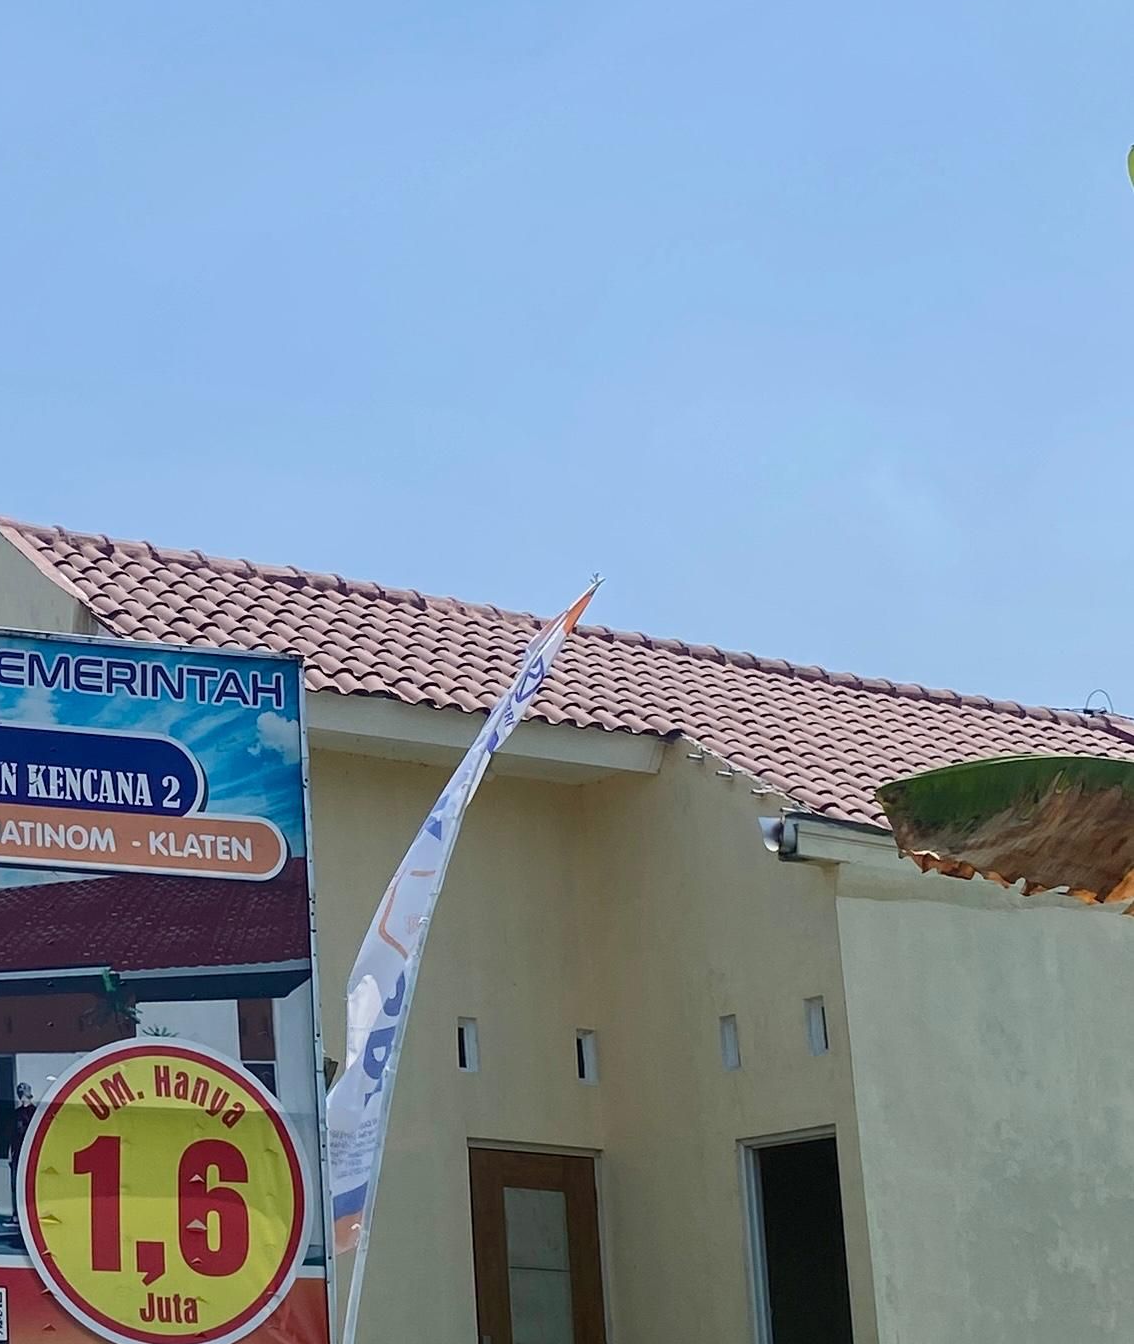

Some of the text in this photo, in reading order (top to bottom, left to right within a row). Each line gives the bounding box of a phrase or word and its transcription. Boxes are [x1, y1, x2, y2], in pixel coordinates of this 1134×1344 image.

[27, 763, 153, 808] KENCANA
[161, 777, 181, 809] 2
[148, 830, 253, 862] KLATEN
[81, 1065, 246, 1129] UM. Hanya
[73, 1135, 250, 1287] 1,6
[139, 1292, 199, 1324] Juta
